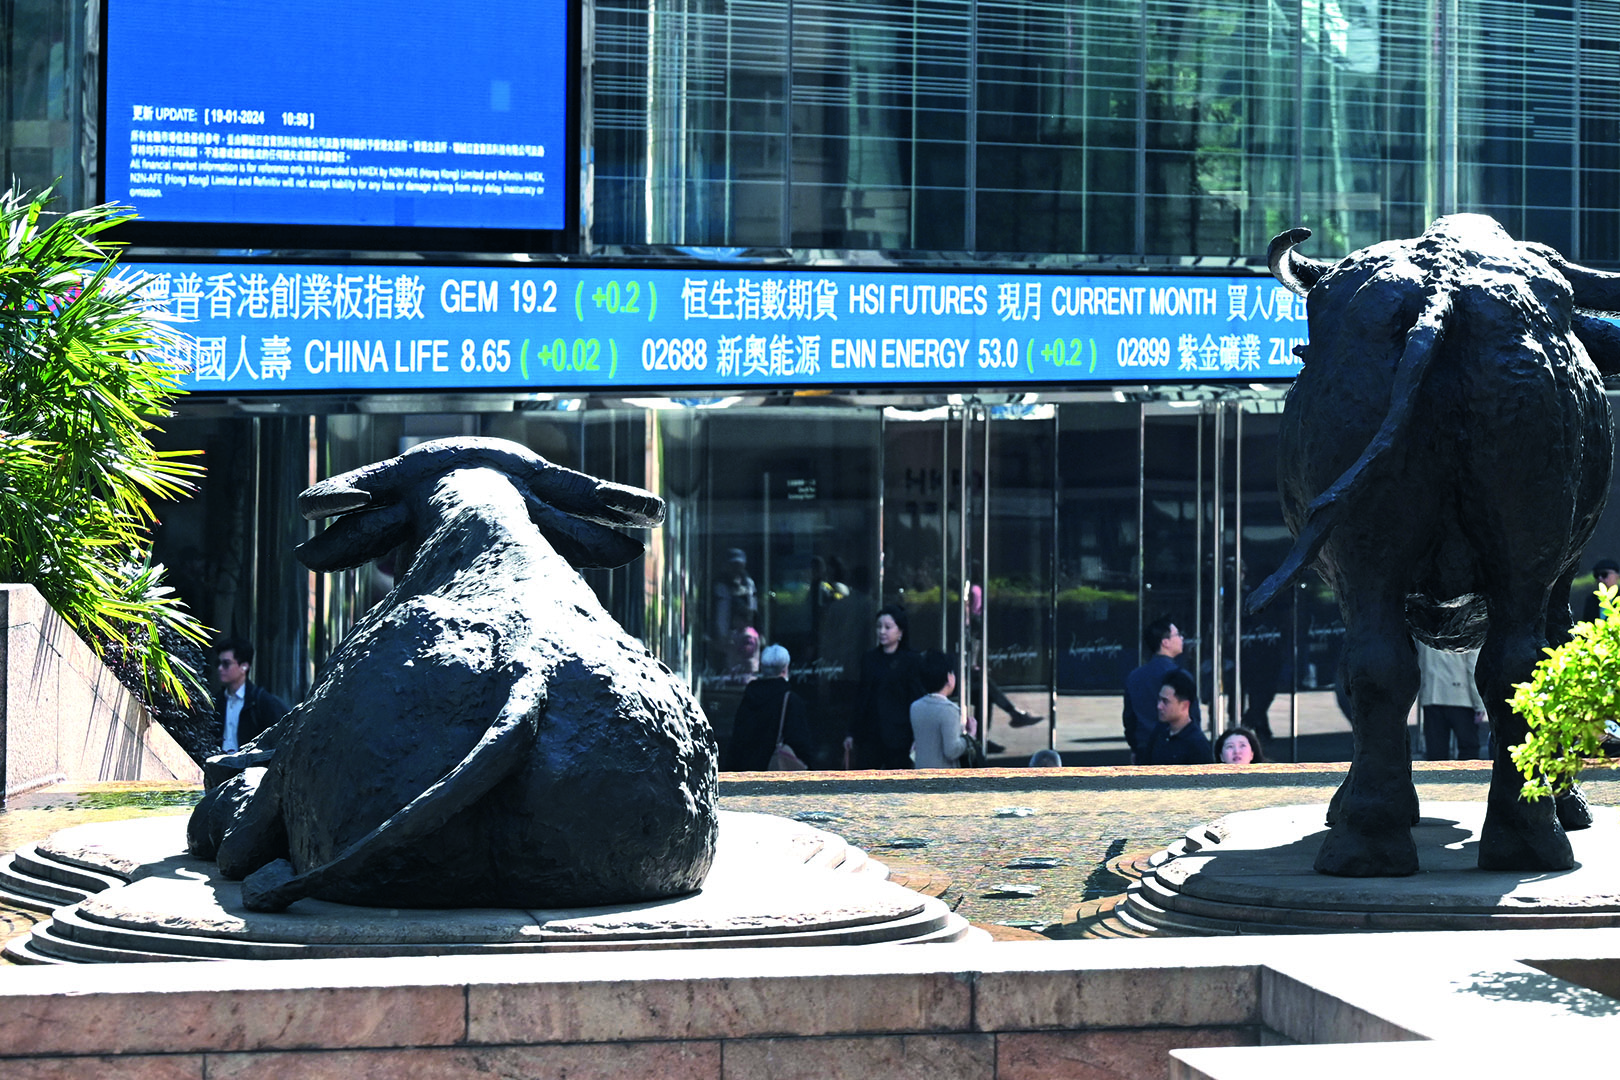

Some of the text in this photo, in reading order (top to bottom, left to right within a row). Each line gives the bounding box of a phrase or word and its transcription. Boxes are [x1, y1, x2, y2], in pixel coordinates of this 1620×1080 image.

[440, 279, 499, 313] GEM
[510, 279, 558, 314] 19.2
[681, 277, 839, 321] 恒生指數期貨
[849, 283, 885, 315] HSI
[890, 284, 988, 316] FUTURES
[997, 282, 1042, 321] 現月
[1051, 285, 1147, 316] CURRENT
[1149, 286, 1217, 317] MONTH
[304, 339, 389, 374] CHINA
[395, 339, 449, 373] LIFE
[460, 338, 511, 373] 8.65
[641, 338, 708, 371] 02688
[716, 333, 821, 377] 新奧能源
[831, 338, 877, 369] ENN
[881, 337, 970, 369] ENERGY
[978, 337, 1019, 369] 53.0
[1117, 337, 1171, 367] 02899
[1177, 333, 1261, 372] 紫金礦業
